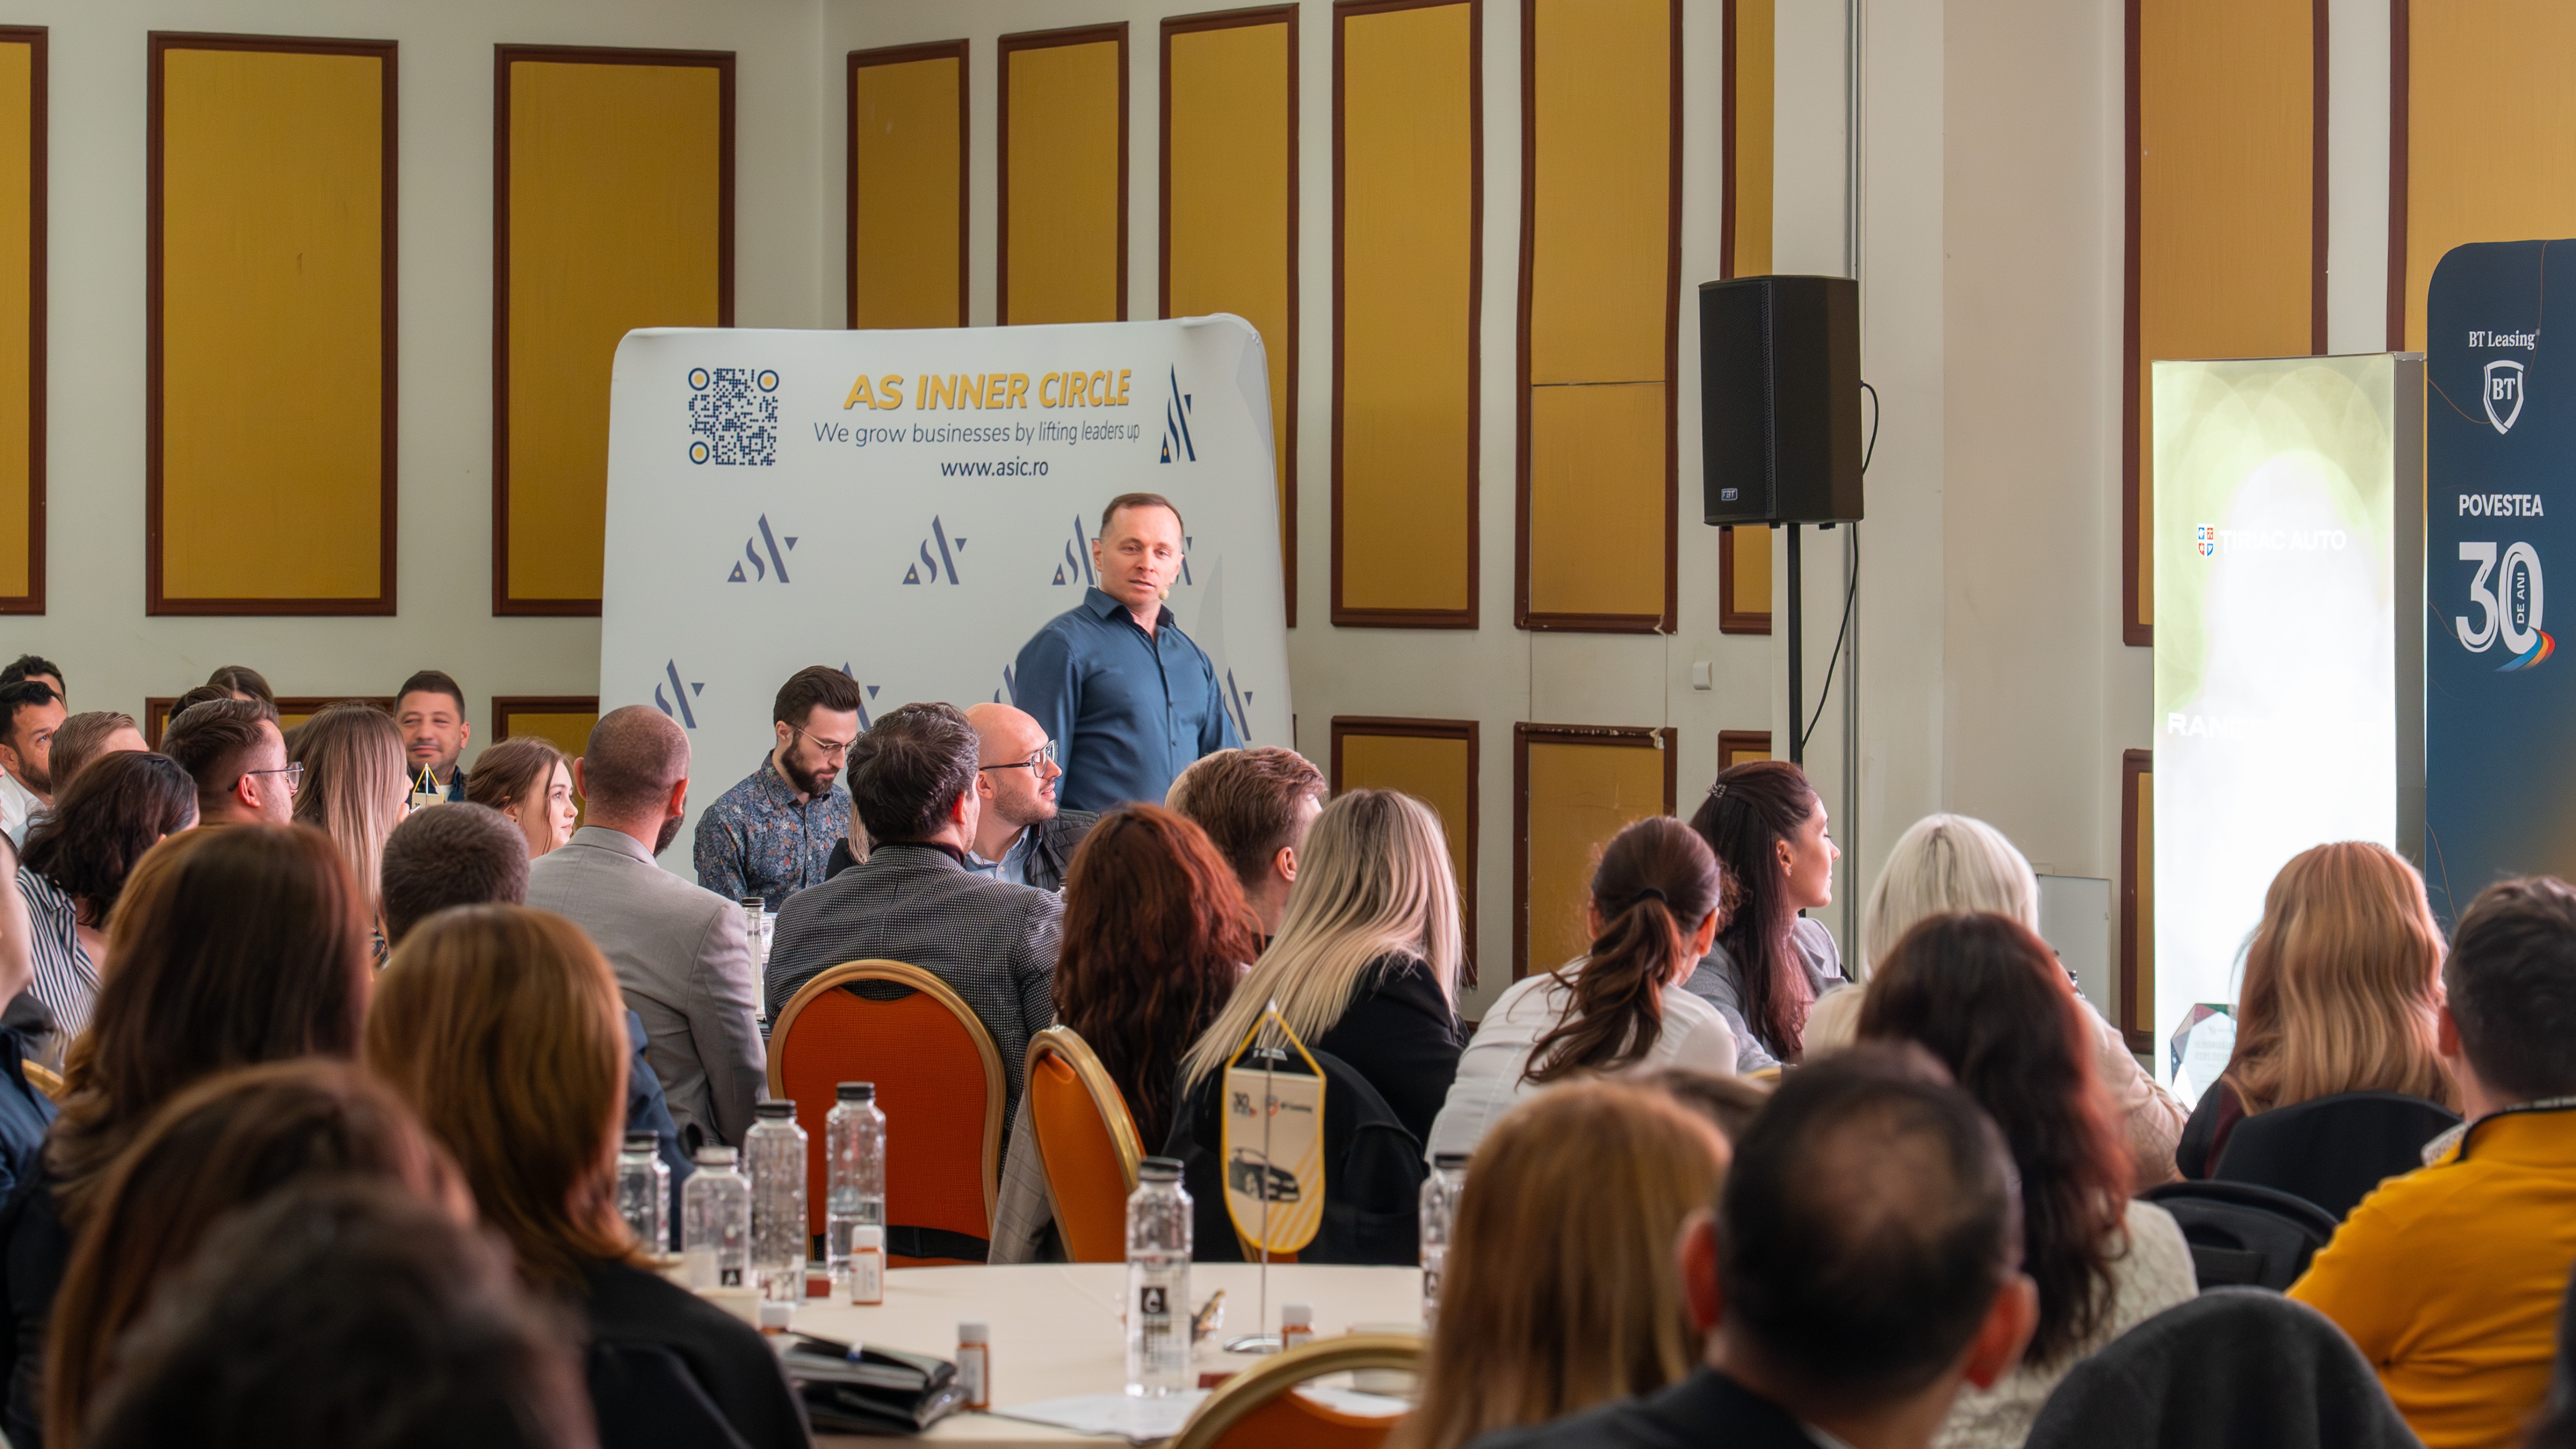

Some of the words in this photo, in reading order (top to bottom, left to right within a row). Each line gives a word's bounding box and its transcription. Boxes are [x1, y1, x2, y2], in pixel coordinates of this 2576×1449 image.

[2469, 331, 2485, 347] BT
[2487, 330, 2535, 350] Leasing
[843, 374, 904, 410] AS
[916, 373, 1029, 410] INNER
[1039, 368, 1132, 408] CIRCLE
[2492, 378, 2516, 400] BT
[814, 422, 849, 442] We
[856, 428, 906, 447] grow
[912, 422, 1010, 443] businesses
[1015, 421, 1035, 446] by
[1038, 420, 1078, 445] lifting
[1081, 420, 1124, 441] leaders
[1127, 423, 1140, 444] up
[941, 456, 1049, 476] www.asic.ro
[2459, 494, 2545, 517] POVESTEA
[2289, 529, 2347, 551] AUTO
[2517, 572, 2525, 598] ANI
[2455, 541, 2544, 655] 30
[2517, 603, 2525, 624] DE
